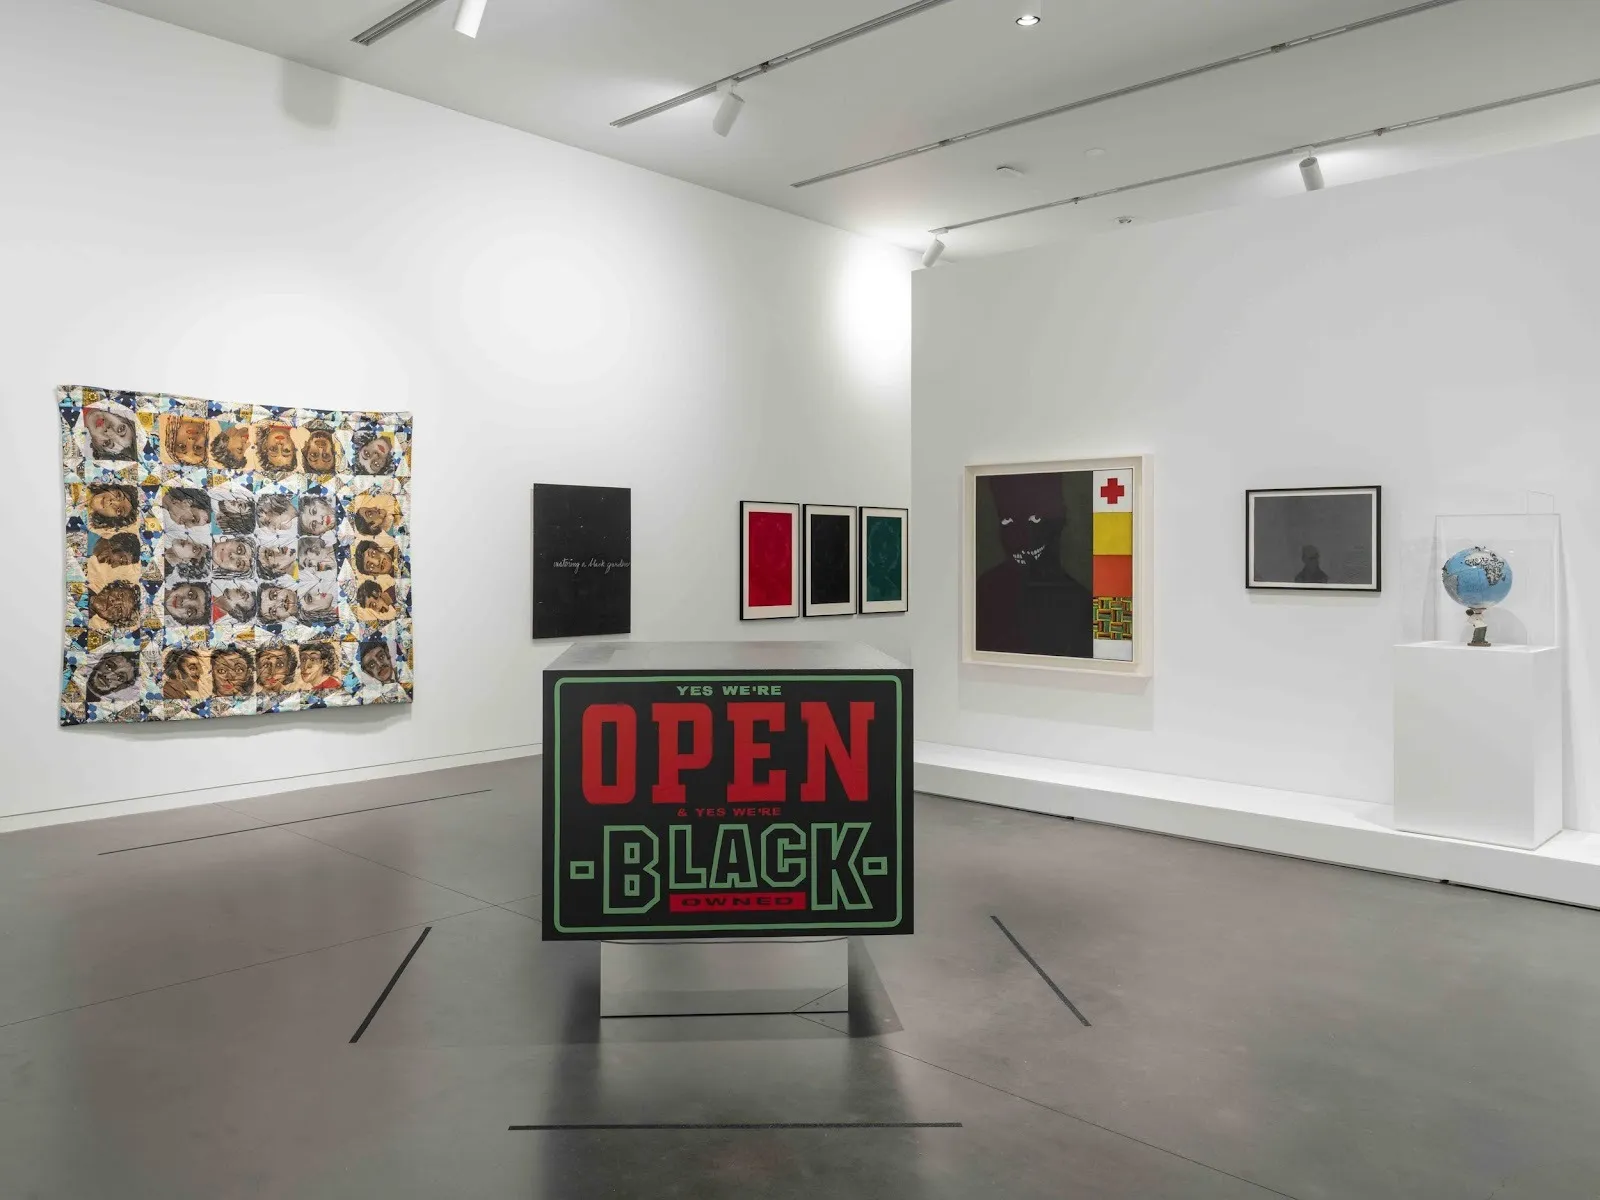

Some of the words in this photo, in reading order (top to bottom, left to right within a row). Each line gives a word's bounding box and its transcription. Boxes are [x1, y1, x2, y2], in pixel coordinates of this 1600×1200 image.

[588, 557, 605, 568] black
[676, 685, 714, 696] YES
[722, 685, 782, 696] WE'RE
[581, 701, 876, 805] OPEN
[677, 807, 687, 817] &
[695, 807, 726, 817] YES
[732, 807, 781, 817] WE'RE
[681, 896, 794, 907] OWNED
